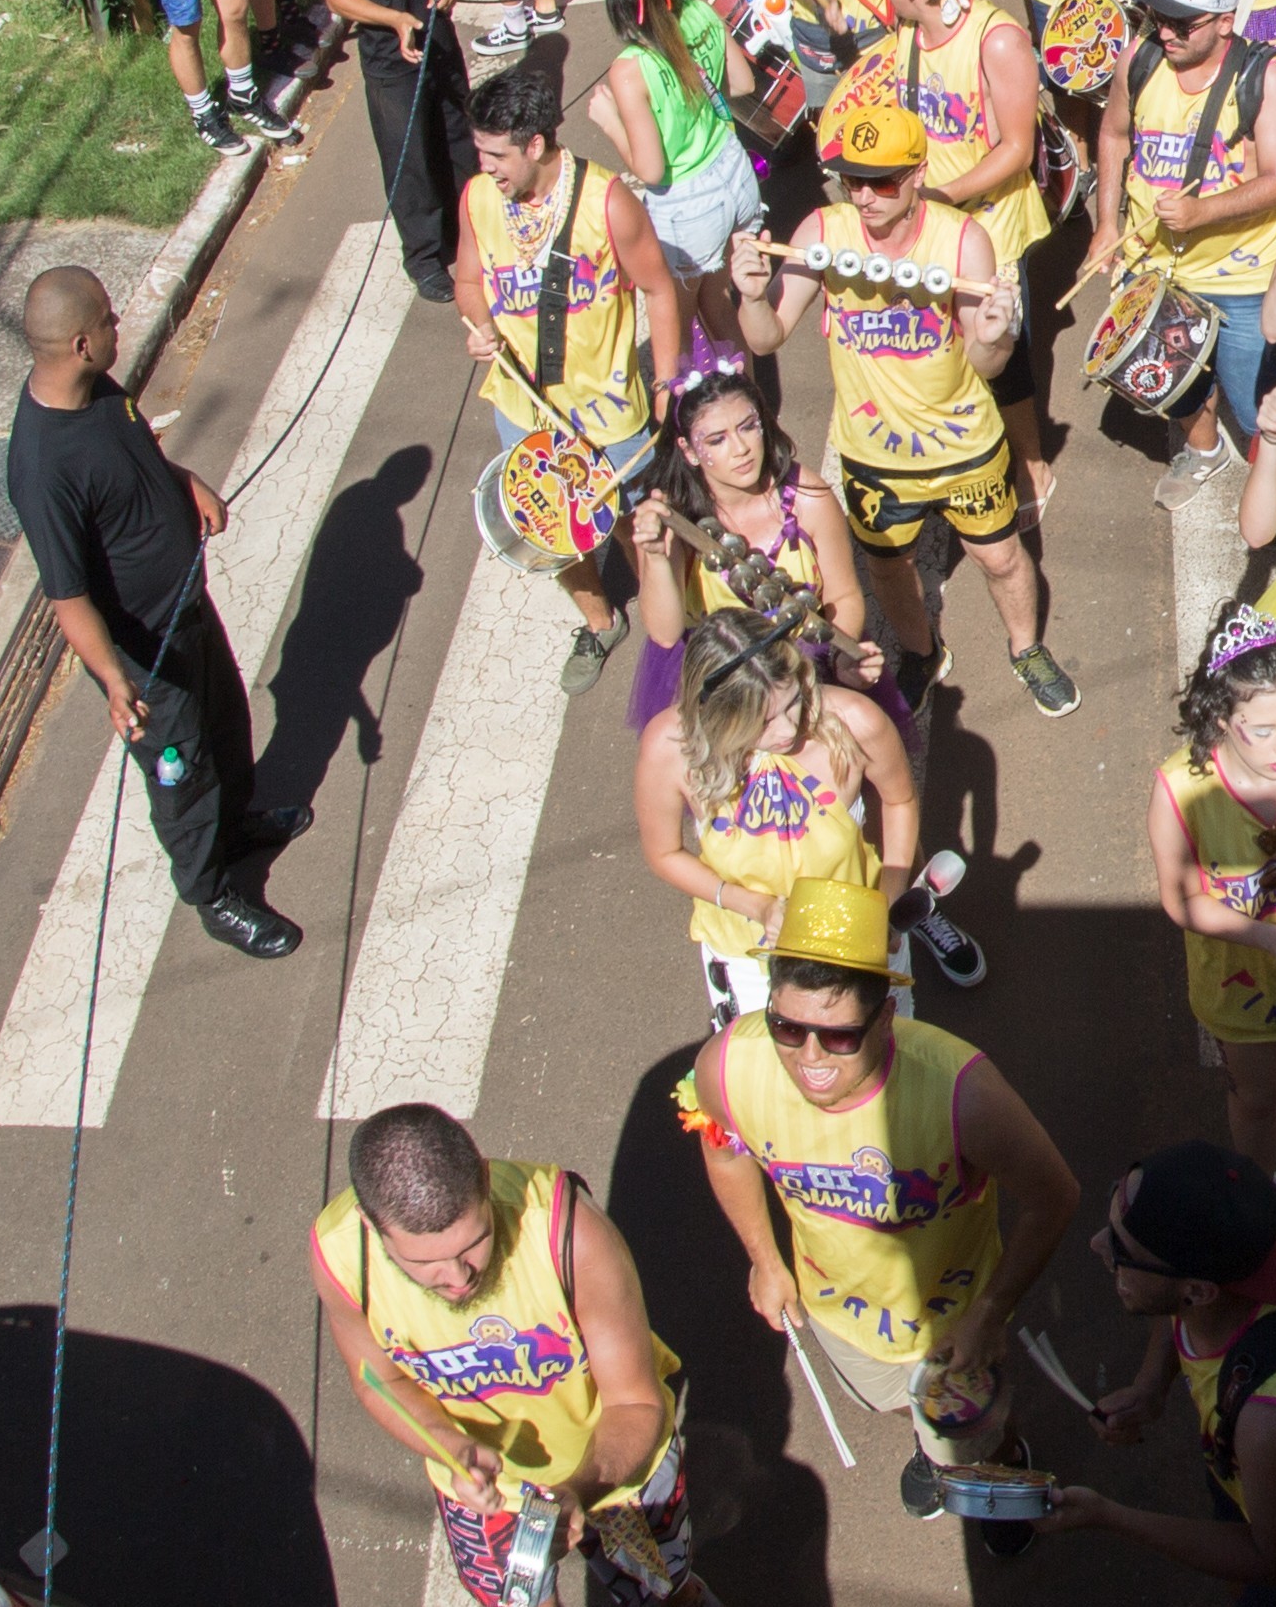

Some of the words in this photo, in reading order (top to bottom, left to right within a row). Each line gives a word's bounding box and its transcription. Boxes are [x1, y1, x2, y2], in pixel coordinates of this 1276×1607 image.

[848, 315, 937, 351] Sumida
[862, 310, 893, 331] OI
[805, 1165, 859, 1193] OI
[781, 1173, 933, 1224] Sumida
[421, 1342, 568, 1398] Sumida
[428, 1345, 489, 1376] OI
